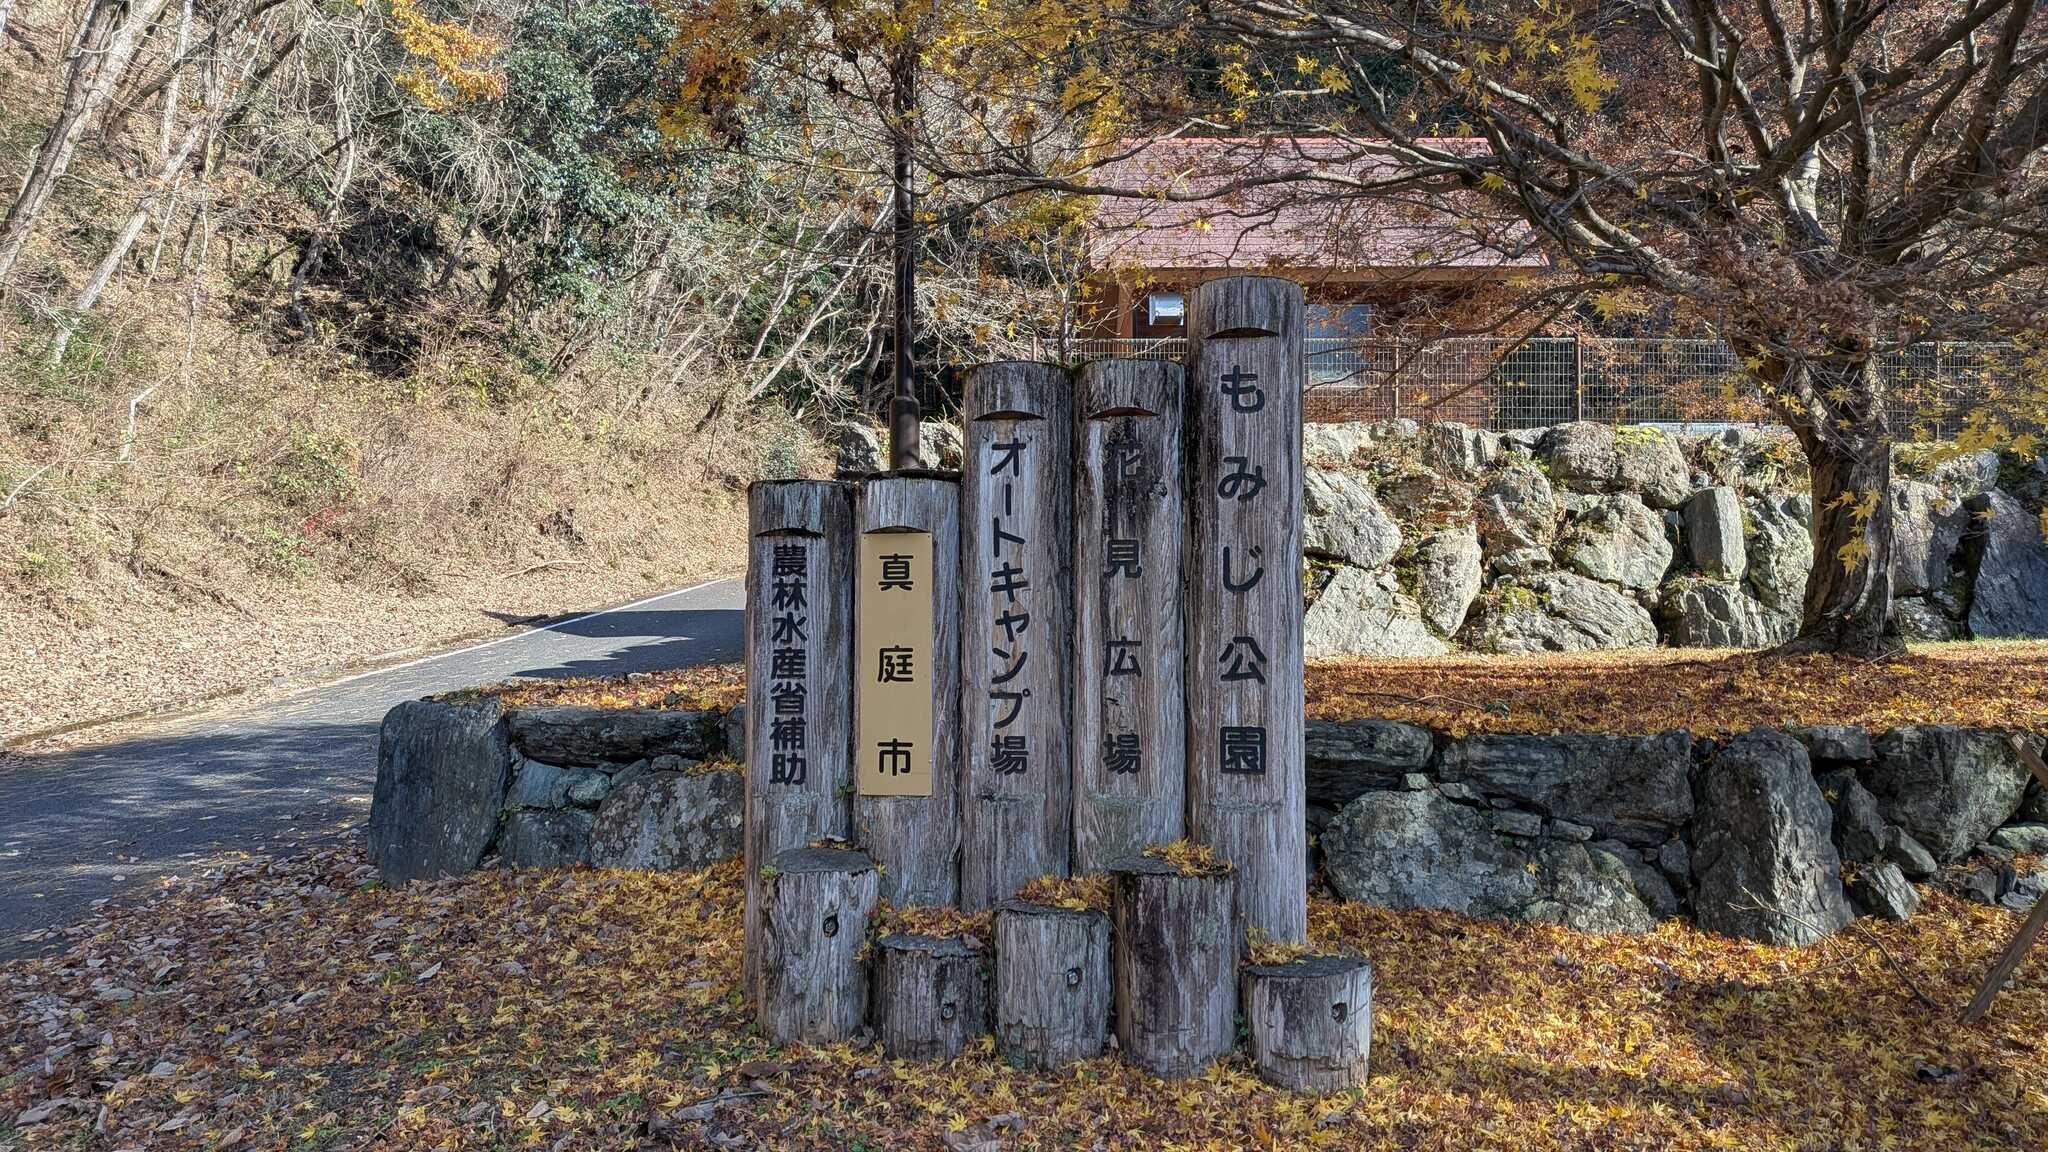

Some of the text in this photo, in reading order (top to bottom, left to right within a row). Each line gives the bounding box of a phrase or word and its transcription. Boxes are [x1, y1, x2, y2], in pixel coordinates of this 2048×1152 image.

[769, 544, 807, 786] 農林水産省補助
[877, 553, 914, 776] 真庭市
[990, 437, 1032, 775] オートキャンプ場
[1103, 438, 1143, 775] 花見広場
[1217, 365, 1268, 775] もみじ公園
